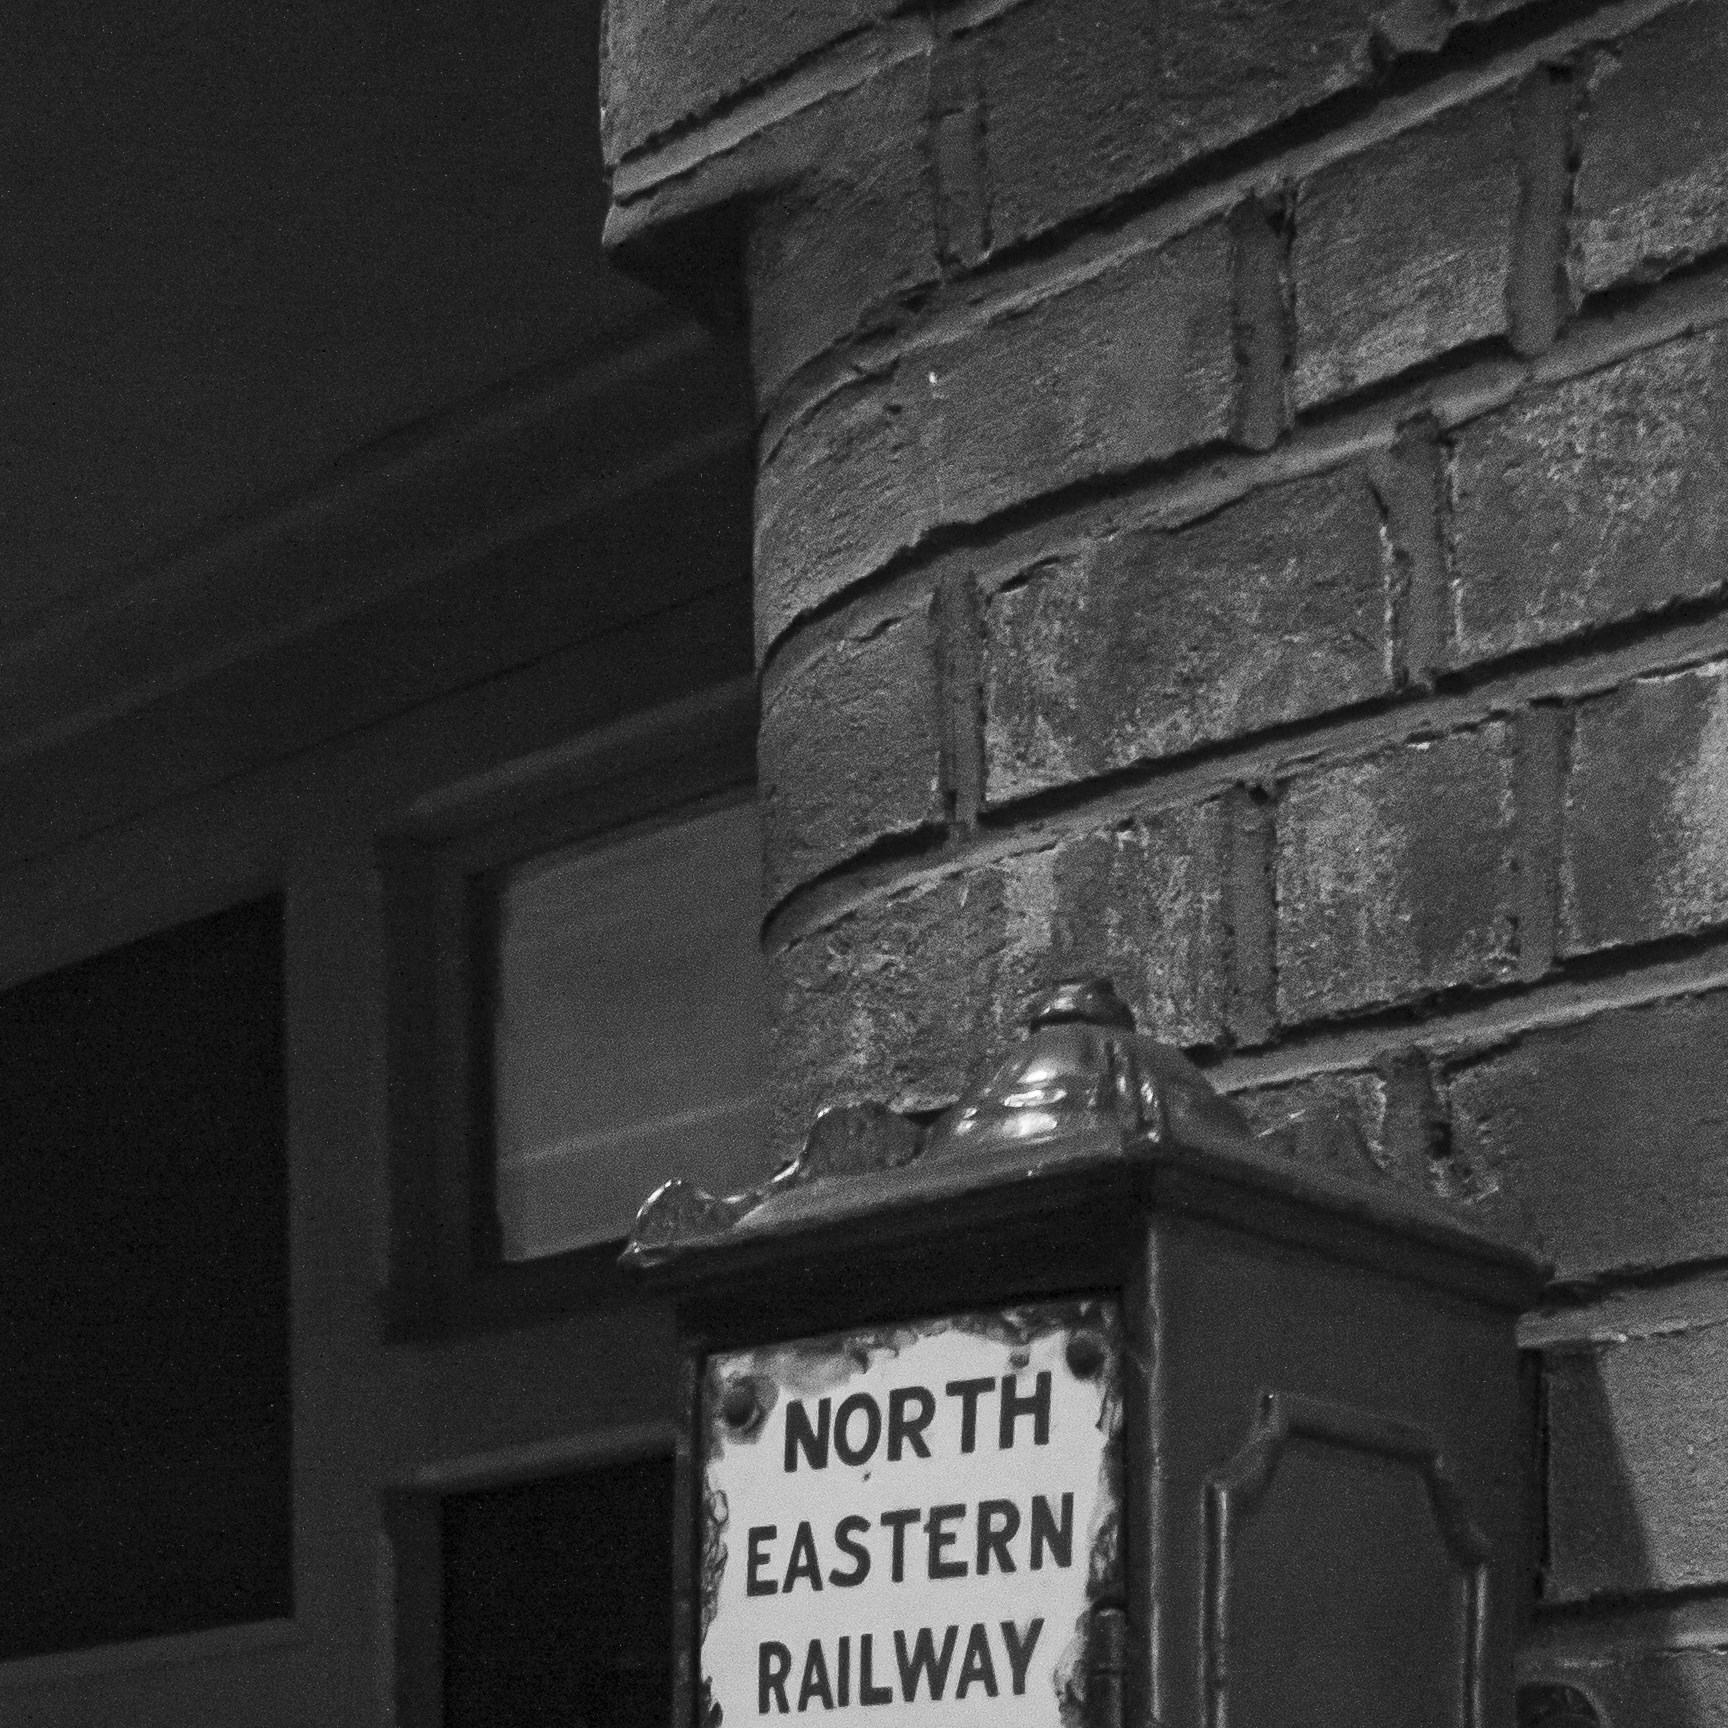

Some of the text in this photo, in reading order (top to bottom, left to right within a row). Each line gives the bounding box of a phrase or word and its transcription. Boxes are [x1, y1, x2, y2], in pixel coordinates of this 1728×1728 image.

[782, 1370, 1053, 1474] NORTH
[745, 1491, 1075, 1598] EASTERN
[757, 1617, 1045, 1715] RAILWAY
